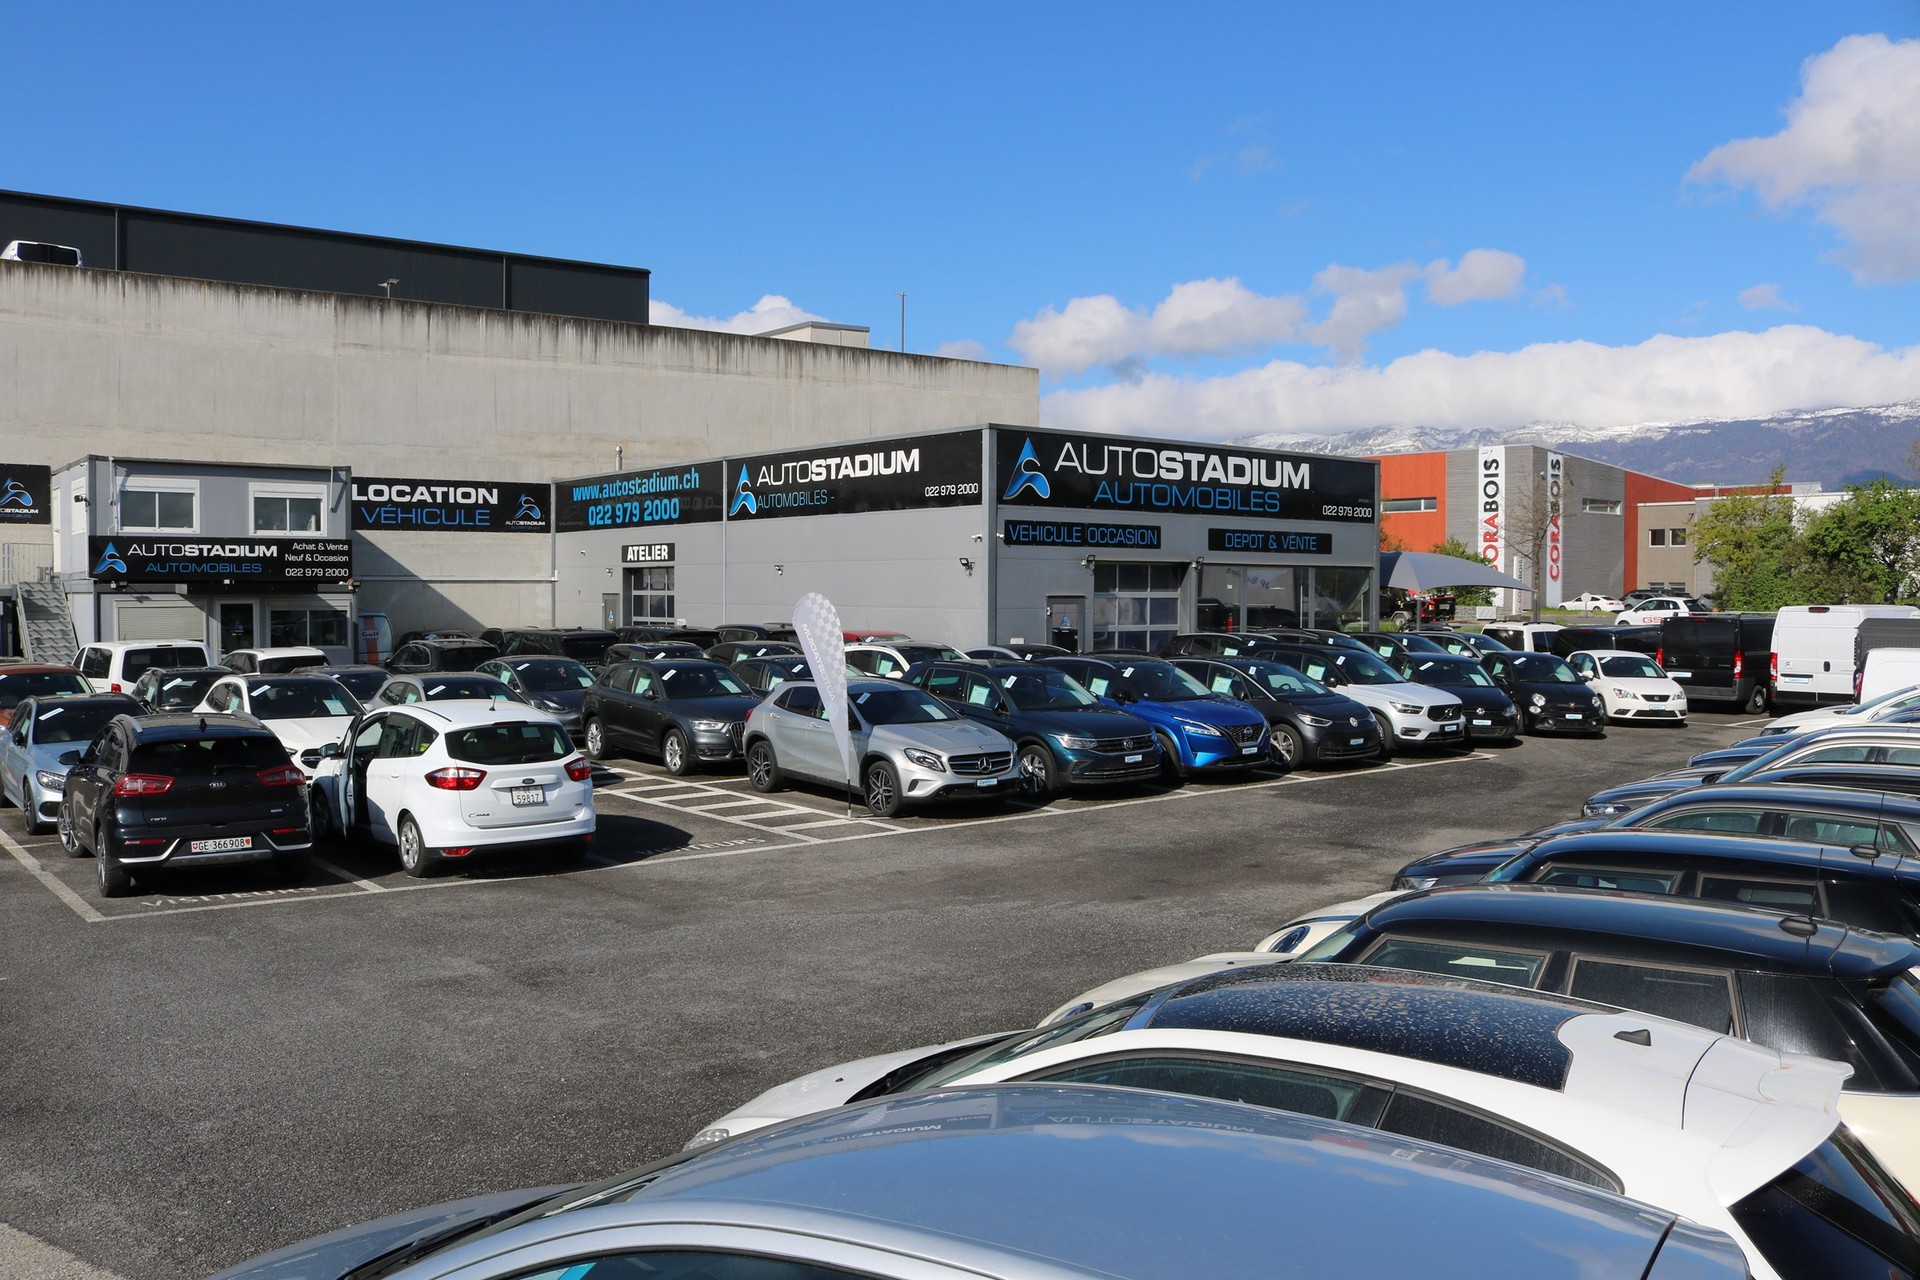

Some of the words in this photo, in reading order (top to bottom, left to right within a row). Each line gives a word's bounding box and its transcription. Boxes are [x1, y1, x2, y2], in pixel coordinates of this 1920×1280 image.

[756, 448, 920, 487] AUTOSTADIUM
[1053, 441, 1311, 490] AUTOSTADIUM
[351, 484, 499, 505] LOCATION
[572, 467, 700, 502] www.autostadium.ch
[925, 486, 939, 497] 022
[940, 484, 956, 496] 979
[957, 482, 979, 495] 2000
[756, 489, 828, 509] AUTOMOBILES
[1093, 480, 1281, 513] AUTOMOBILES
[361, 504, 491, 526] VÉHICULE
[588, 505, 612, 526] 022
[615, 501, 640, 524] 979
[643, 497, 680, 521] 2000
[1322, 504, 1337, 516] 022
[1338, 506, 1352, 517] 979
[1354, 506, 1372, 518] 2000
[1483, 458, 1500, 571] ORABOIS
[1009, 524, 1082, 543] VEHICULE
[1087, 527, 1158, 545] OCCASION
[1225, 532, 1264, 549] DEPOT
[1268, 534, 1278, 549] &
[1281, 535, 1317, 551] VENTE
[127, 543, 278, 557] AUTOSTADIUM
[292, 542, 316, 551] Achat
[318, 543, 325, 551] &
[326, 543, 349, 551] Vente
[627, 544, 669, 561] ATELIER
[145, 562, 262, 573] AUTOMOBILES
[284, 554, 304, 562] Neuf
[305, 554, 312, 562] &
[313, 554, 349, 562] Occasion
[285, 568, 304, 577] 022
[305, 568, 323, 577] 979
[325, 568, 349, 577] 2000
